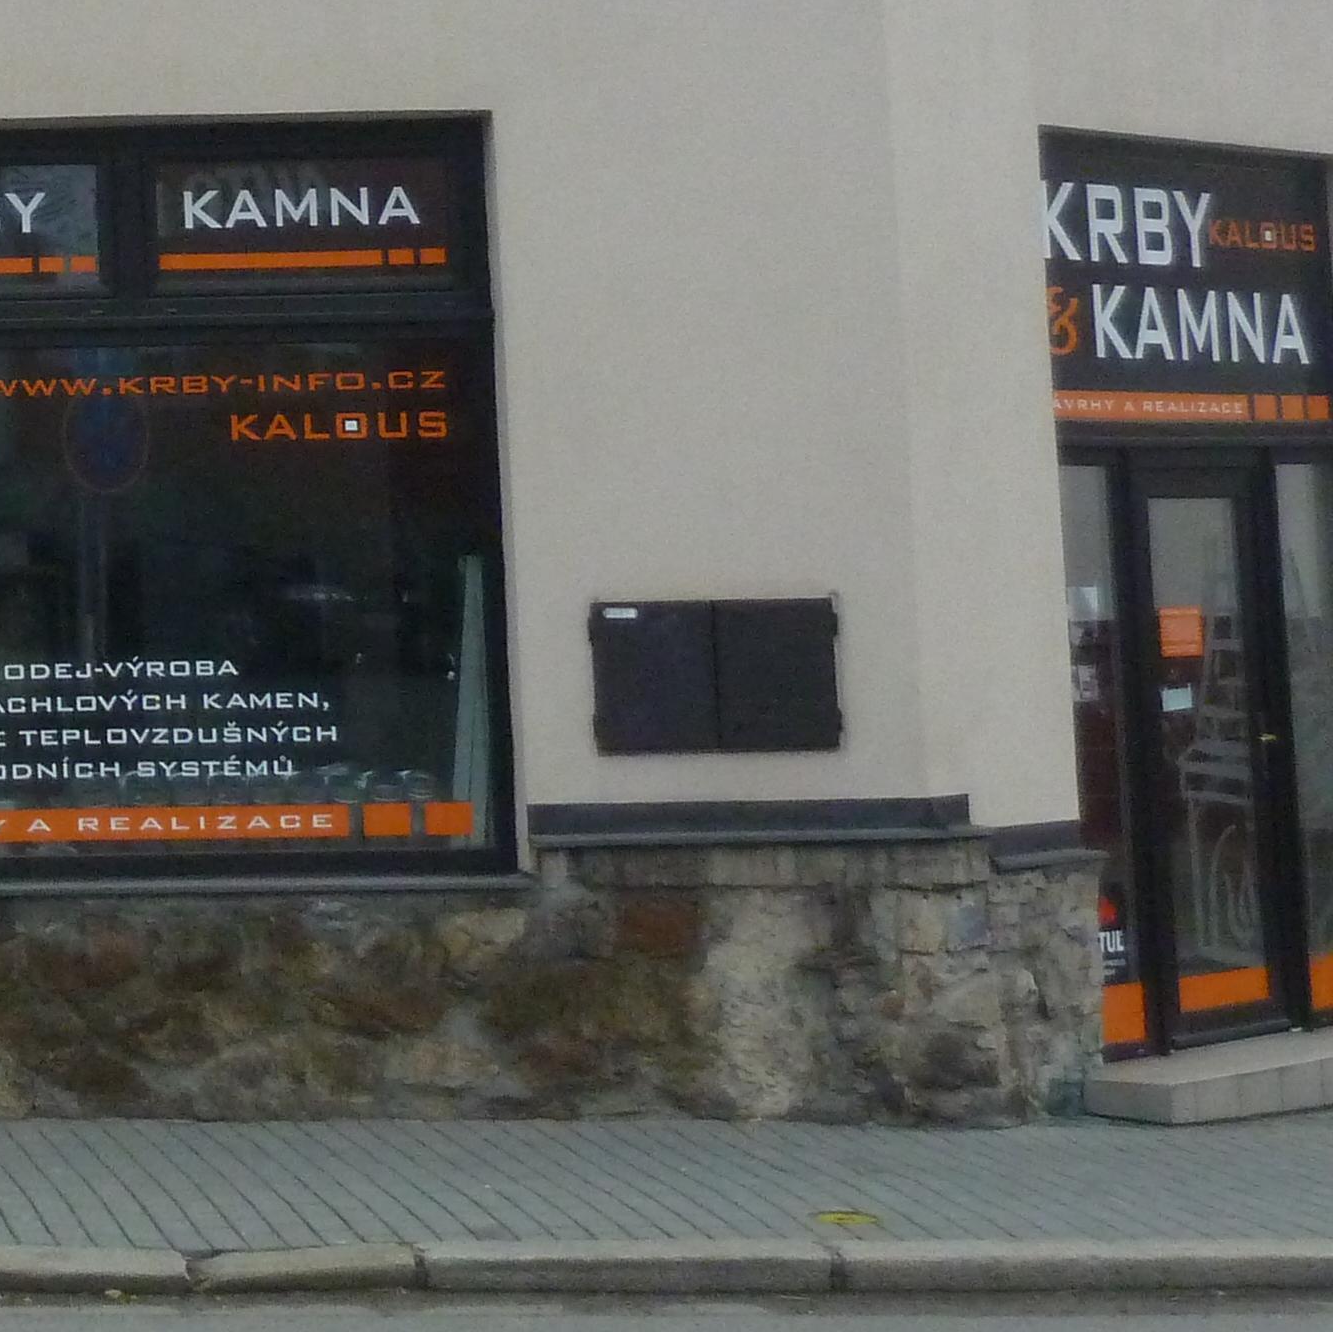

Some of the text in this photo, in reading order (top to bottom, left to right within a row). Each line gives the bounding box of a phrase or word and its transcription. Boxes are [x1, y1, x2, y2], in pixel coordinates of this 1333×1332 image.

[182, 185, 420, 230] KAMNA
[1043, 180, 1318, 268] KRBY KALOUS
[1092, 283, 1310, 366] KAMNA
[1143, 400, 1244, 414] REALIZACE
[230, 411, 448, 441] KALOUS
[204, 692, 330, 712] KAMEN,
[19, 720, 337, 747] TEPLOVZDUŠNÝCH
[137, 755, 293, 777] SYSTÉMŮ
[28, 819, 51, 833] A
[77, 814, 333, 833] REALIZACE
